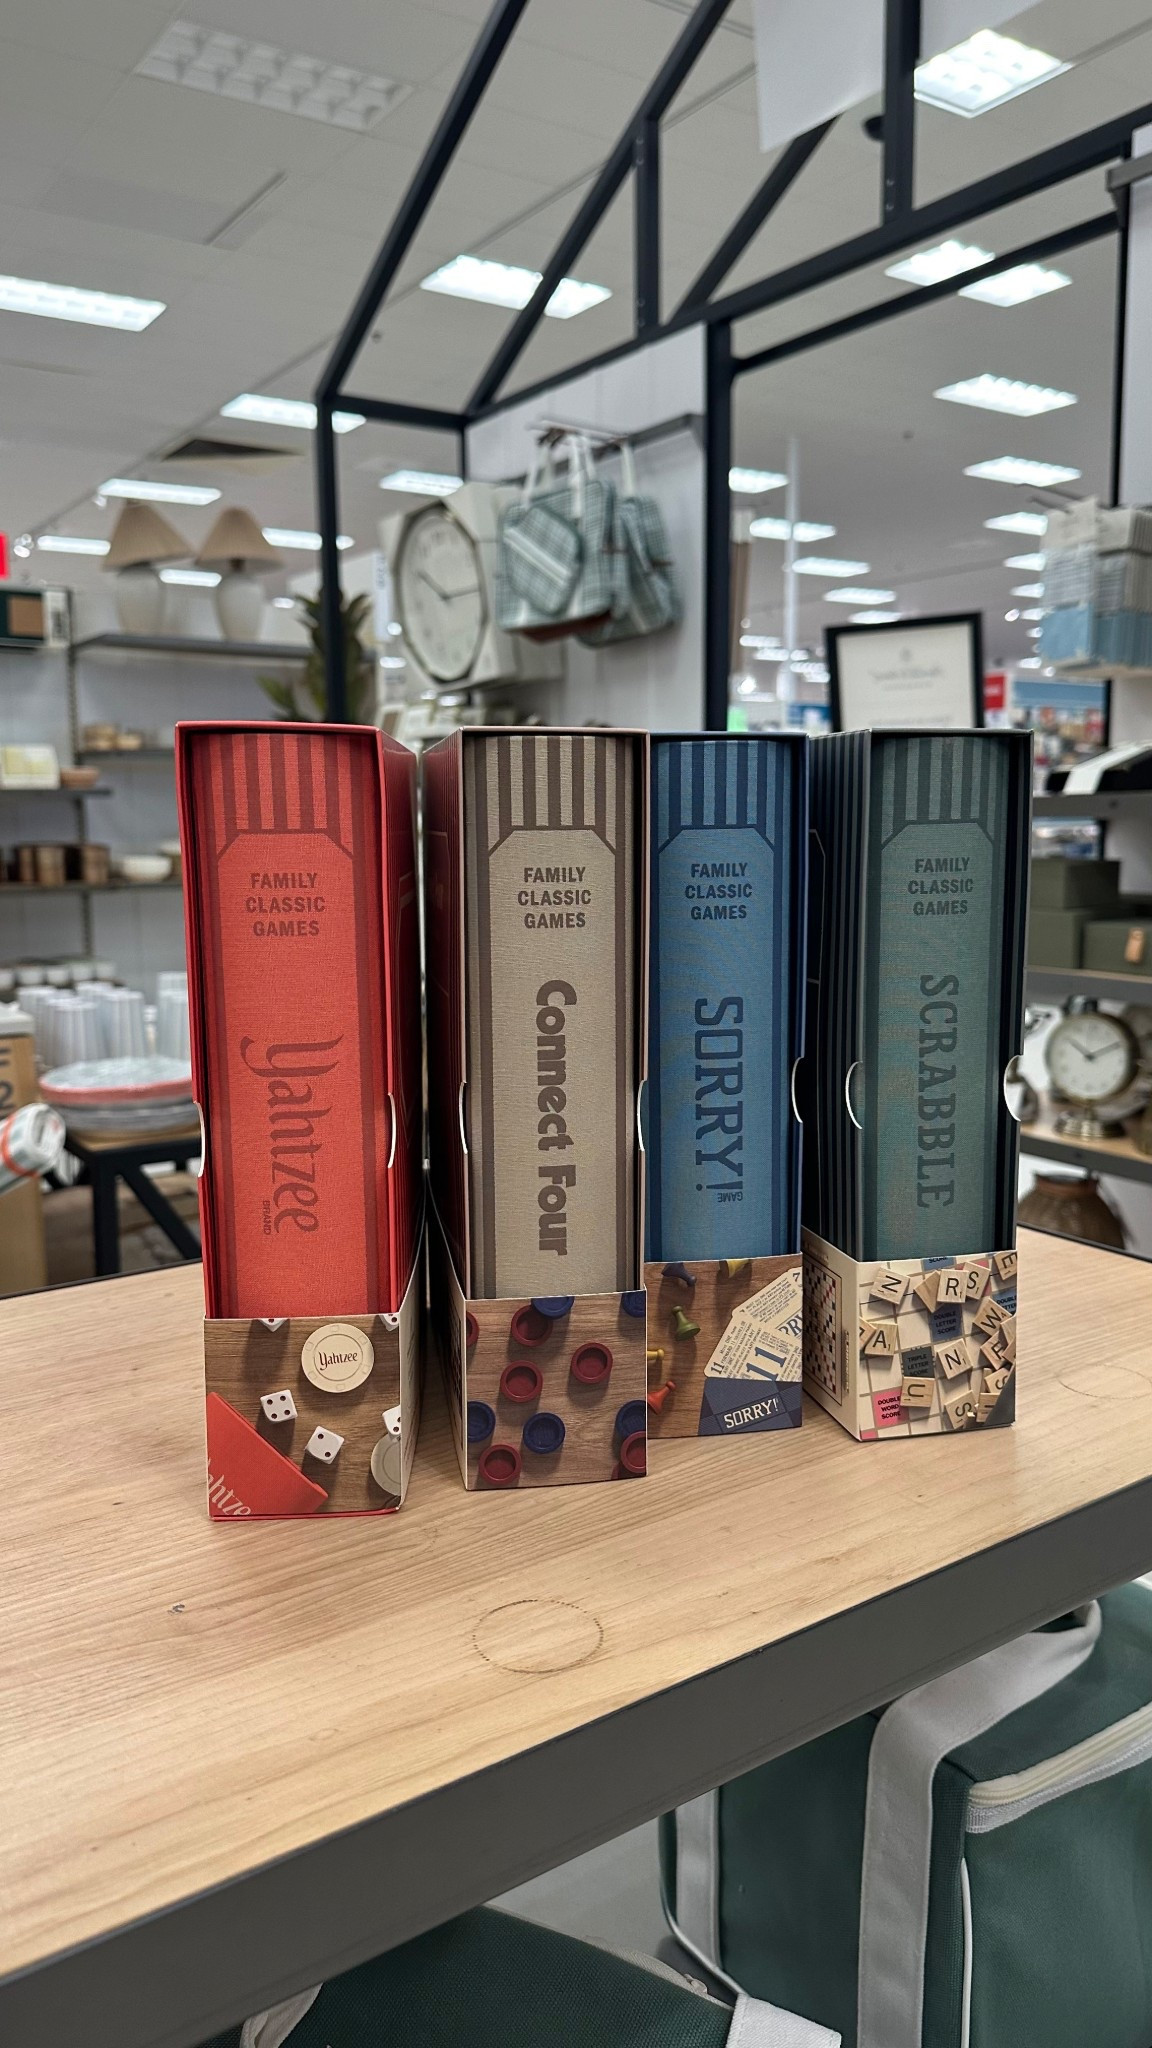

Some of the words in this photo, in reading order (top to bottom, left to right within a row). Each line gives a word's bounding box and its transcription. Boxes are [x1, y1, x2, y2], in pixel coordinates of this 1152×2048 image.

[691, 862, 748, 878] FAMILY
[915, 857, 970, 873] FAMILY
[250, 872, 318, 889] FAMILY
[524, 867, 586, 883] FAMILY
[685, 883, 753, 899] CLASSIC
[907, 878, 974, 894] CLASSIC
[245, 896, 326, 913] CLASSIC
[517, 889, 592, 906] CLASSIC
[690, 904, 747, 920] GAMES
[913, 899, 968, 916] GAMES
[252, 920, 320, 937] GAMES
[524, 912, 586, 929] GAMES
[536, 979, 578, 1151] Connect
[695, 996, 744, 1191] SORRY!
[917, 974, 959, 1208] SCRABBLE
[240, 1033, 344, 1234] Yahtzee
[717, 1191, 744, 1203] GAME
[537, 1165, 577, 1256] Four
[881, 1275, 902, 1294] N
[945, 1277, 960, 1297] R
[967, 1271, 979, 1289] S
[980, 1307, 1002, 1330] W
[872, 1330, 887, 1349] A
[318, 1350, 358, 1371] Yahtzee
[745, 1346, 787, 1382] 11
[944, 1348, 962, 1370] N
[907, 1383, 926, 1397] U
[877, 1395, 901, 1406] DOUBLE
[723, 1397, 779, 1429] SORRY!
[881, 1410, 901, 1420] SCORE
